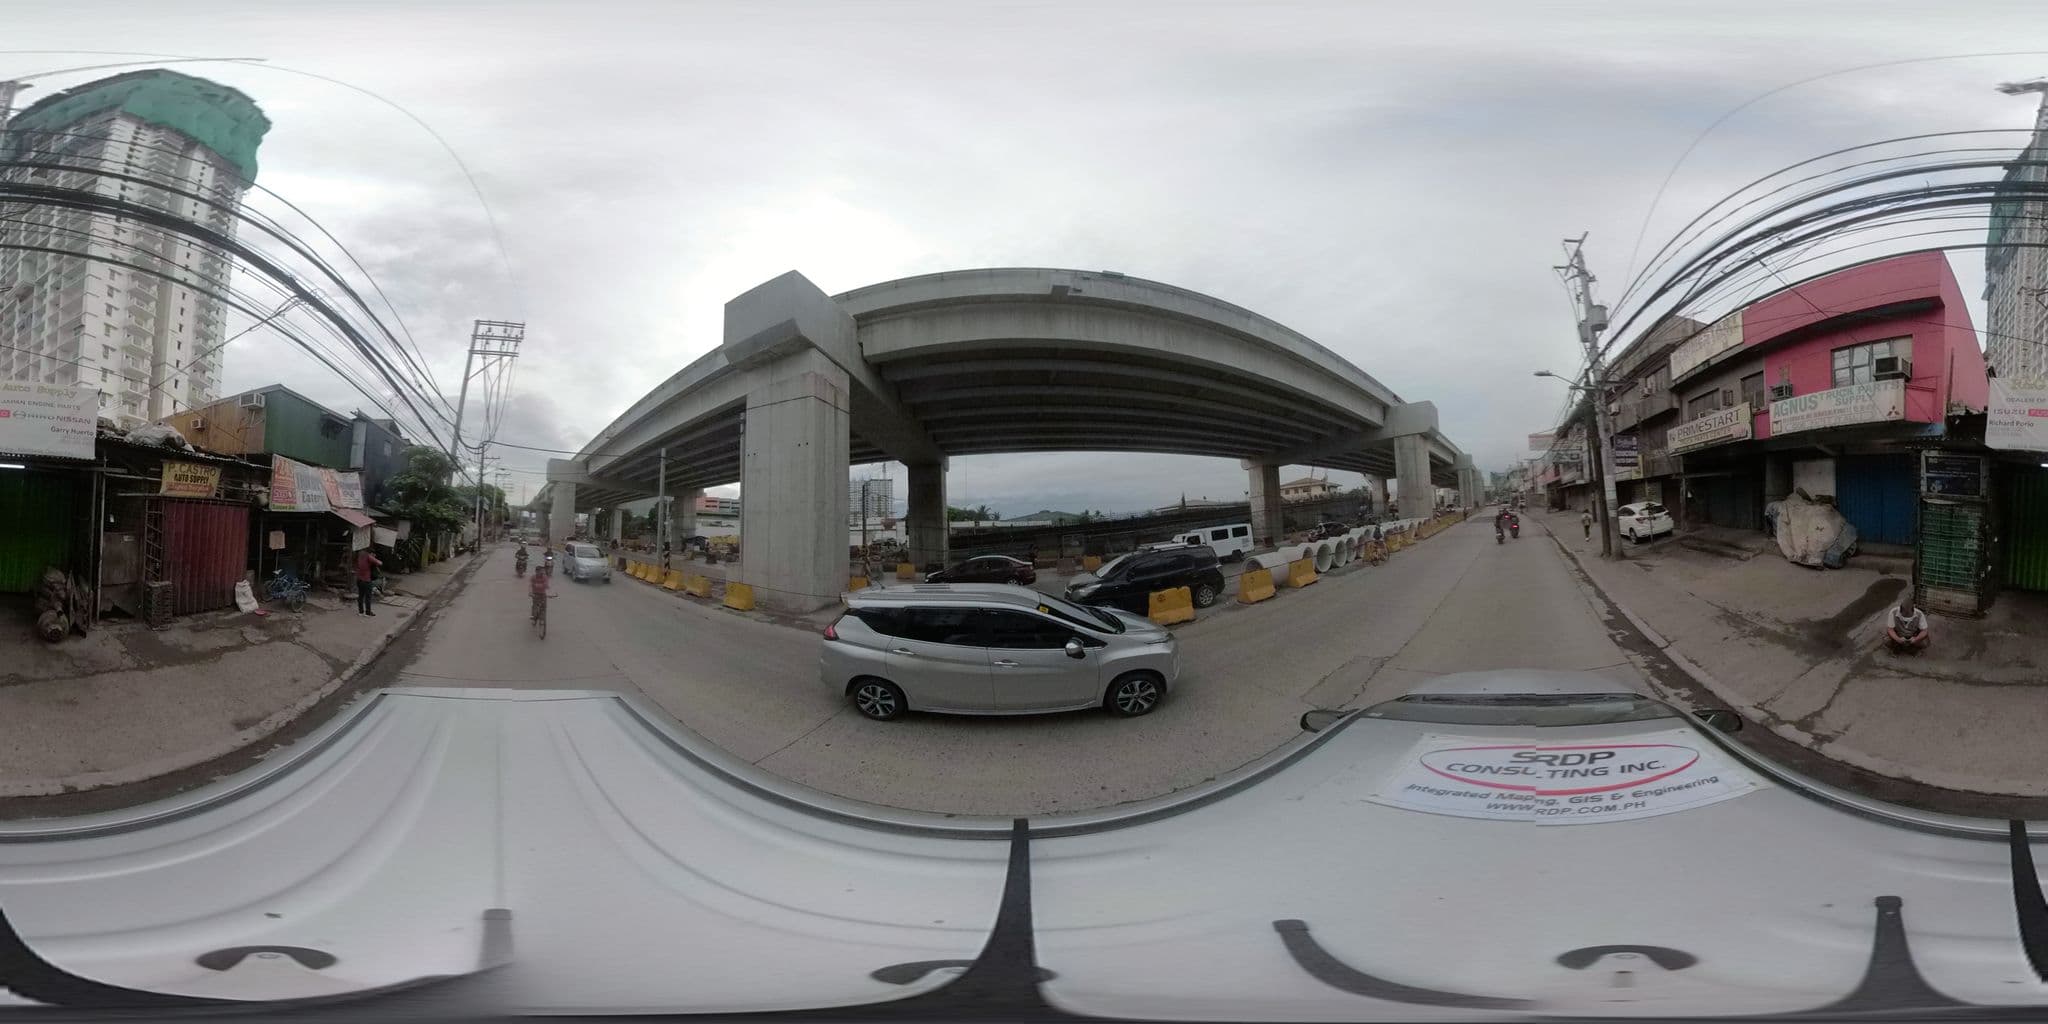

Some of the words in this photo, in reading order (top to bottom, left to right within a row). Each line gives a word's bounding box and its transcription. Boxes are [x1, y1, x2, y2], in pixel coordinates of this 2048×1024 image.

[1773, 394, 1819, 417] AGNUS
[1858, 380, 1902, 396] PARTS
[56, 415, 91, 425] NISSAN
[1677, 409, 1740, 436] PRIMESTART
[50, 426, 69, 435] Garry
[180, 463, 217, 477] CASTRO
[174, 473, 189, 482] AUTO
[190, 474, 209, 484] SUPPLY
[1620, 760, 1667, 773] INC.
[1405, 783, 1491, 799] Integrated
[1568, 794, 1603, 804] GIS
[1611, 792, 1625, 801] &
[1632, 775, 1720, 798] Engineering
